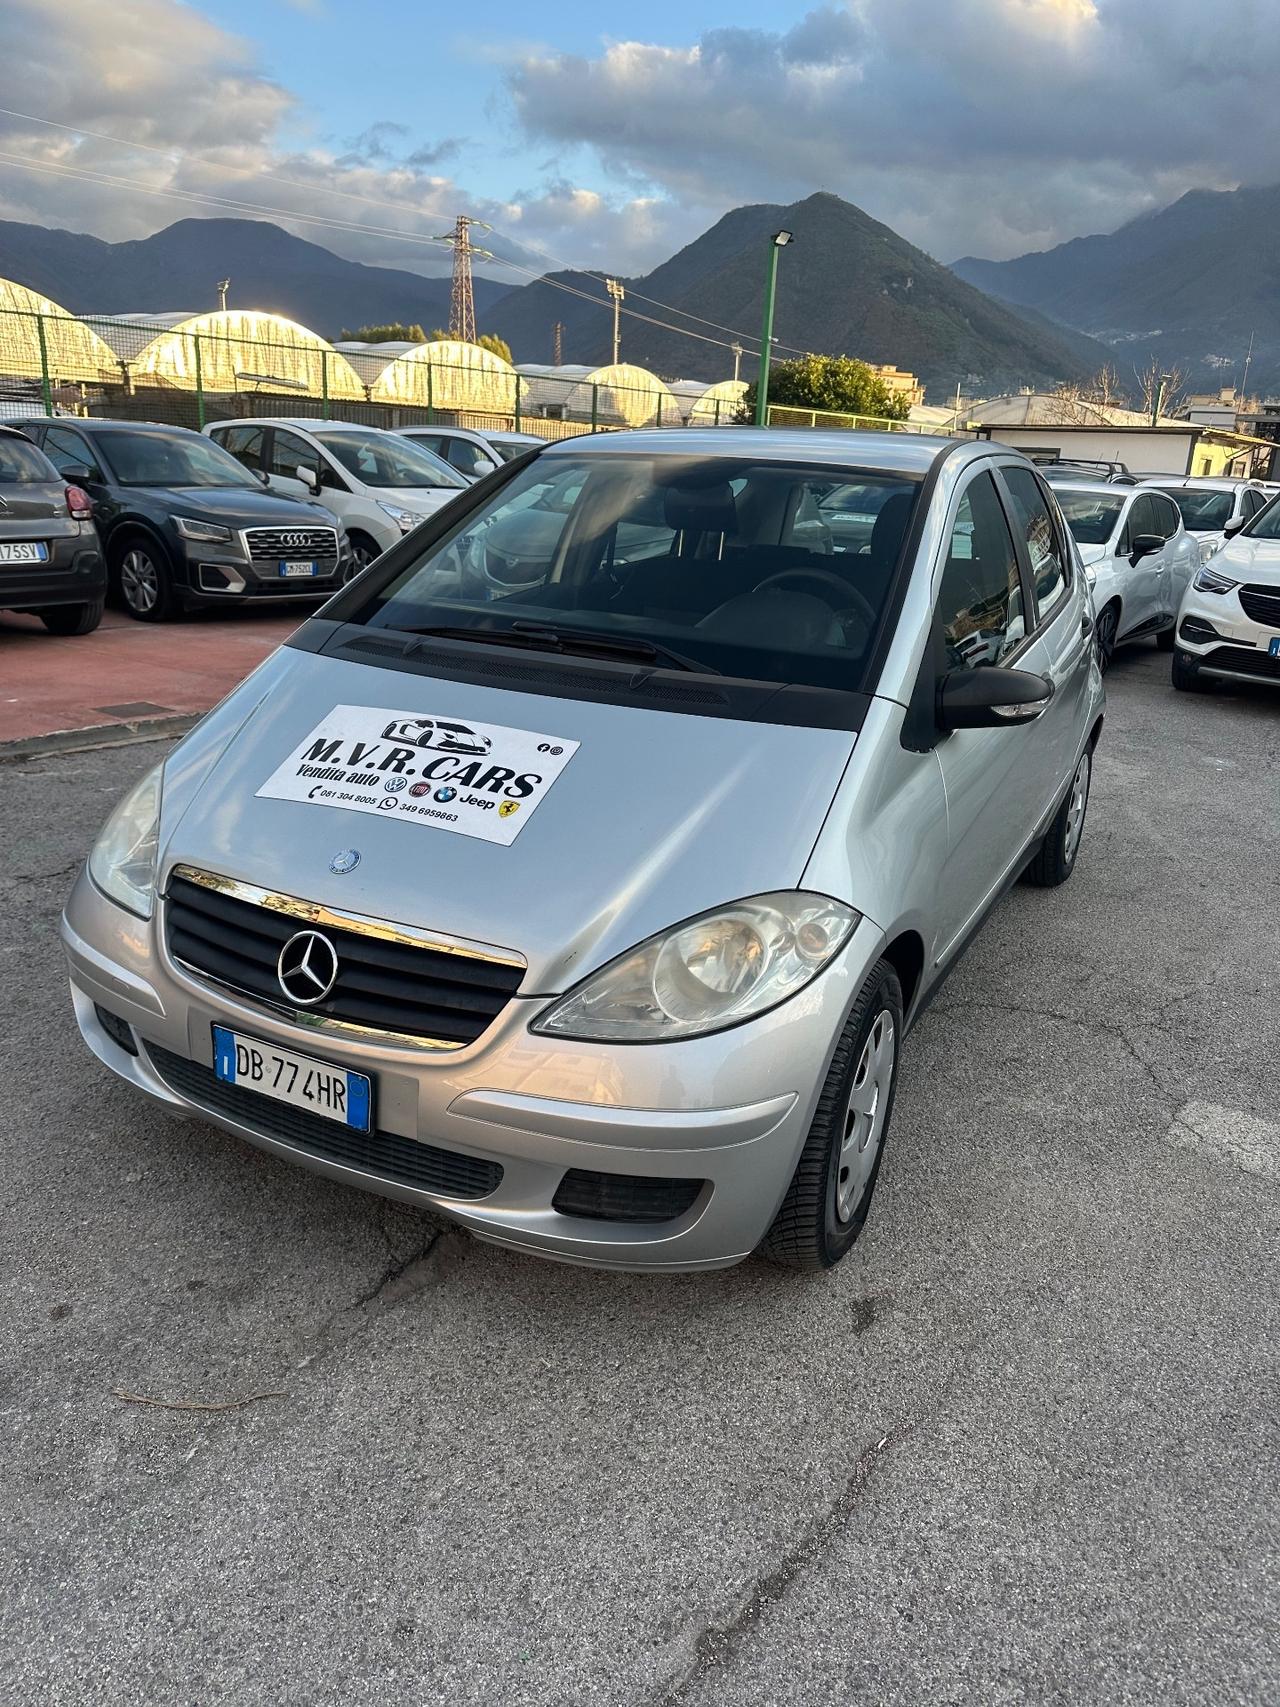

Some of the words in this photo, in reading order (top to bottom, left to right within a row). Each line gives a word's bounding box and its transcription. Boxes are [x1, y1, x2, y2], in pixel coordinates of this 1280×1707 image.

[296, 764, 346, 781] Vendita
[346, 772, 381, 787] auto
[422, 756, 542, 799] CARS
[320, 790, 337, 798] 081
[337, 793, 354, 801] 304
[354, 796, 378, 805] 8005
[399, 804, 418, 813] 349
[418, 807, 459, 822] 6959863
[459, 794, 496, 810] Jeep
